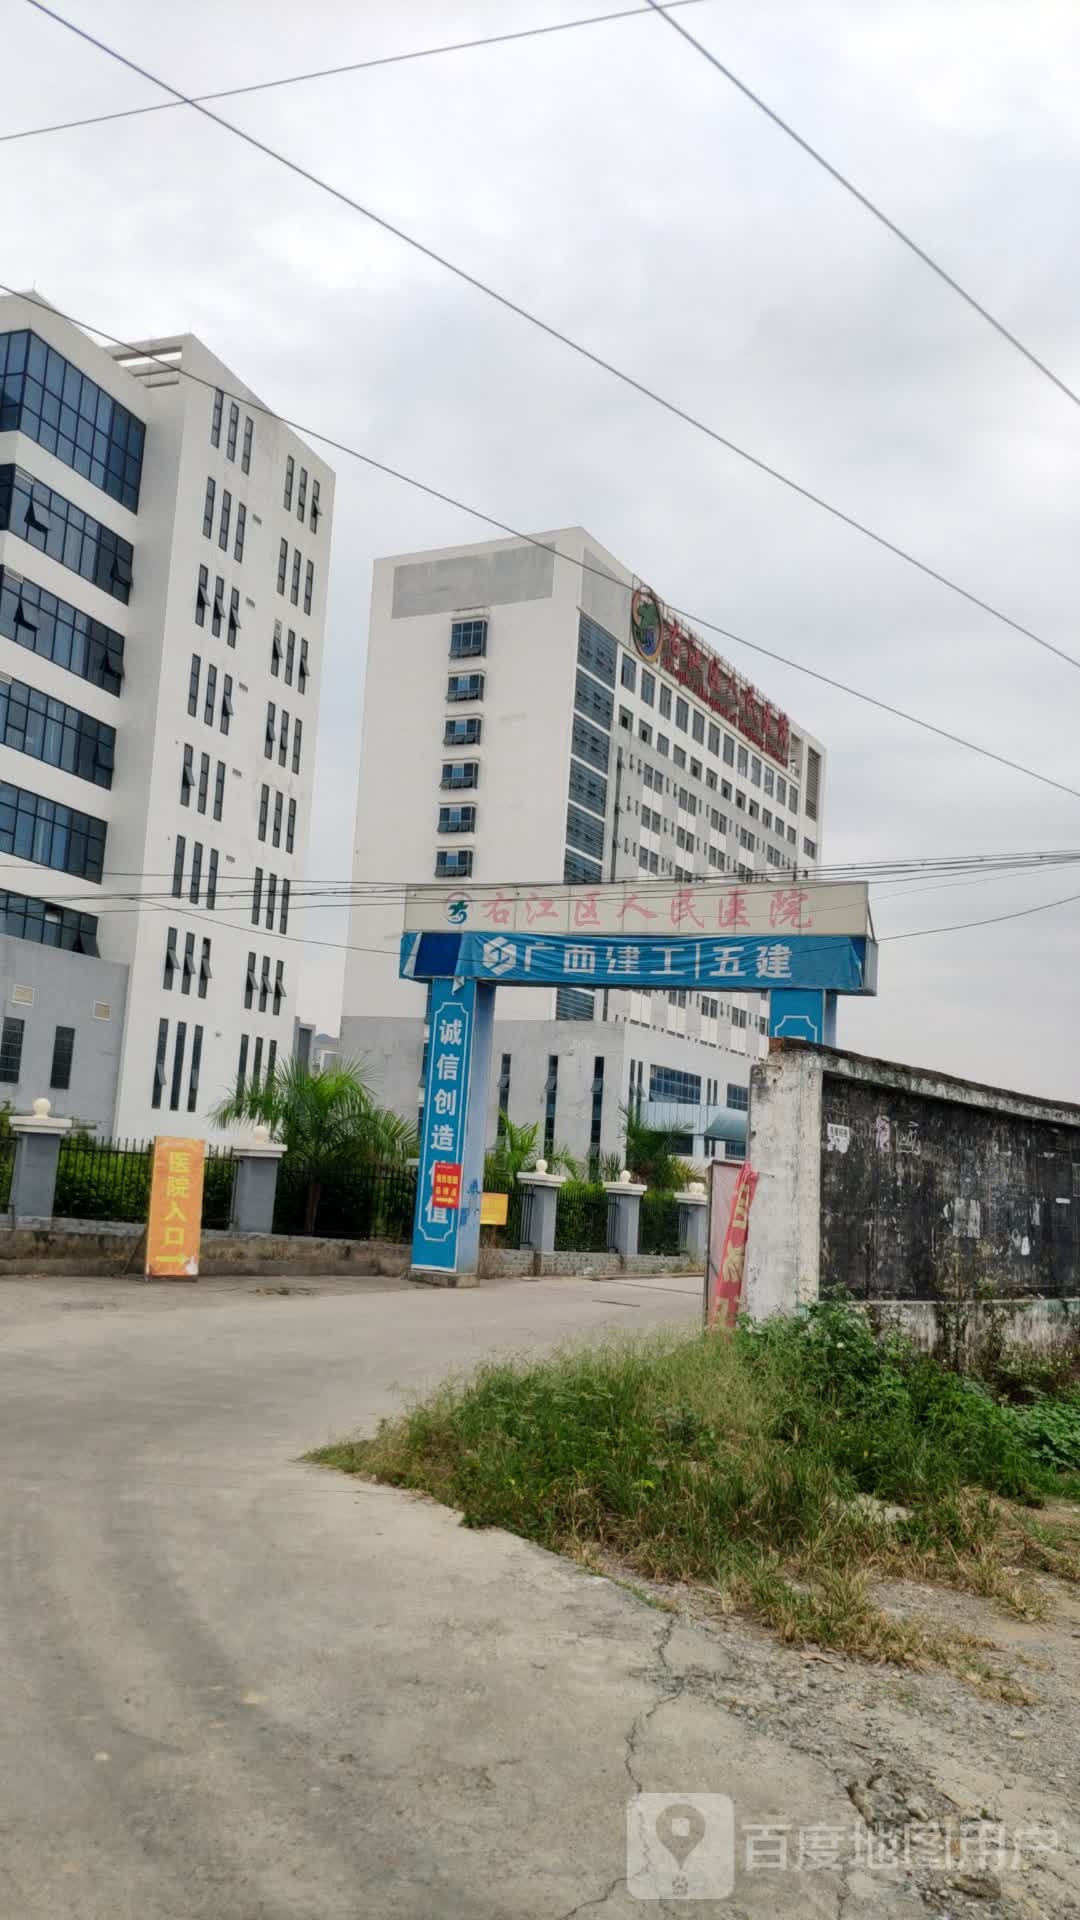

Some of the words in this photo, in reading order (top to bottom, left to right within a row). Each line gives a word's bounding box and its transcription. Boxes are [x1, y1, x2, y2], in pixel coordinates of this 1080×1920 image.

[481, 889, 814, 929] 右江区人民医院
[424, 1019, 462, 1224] 诚信创造值
[162, 1151, 192, 1246] 医院入口
